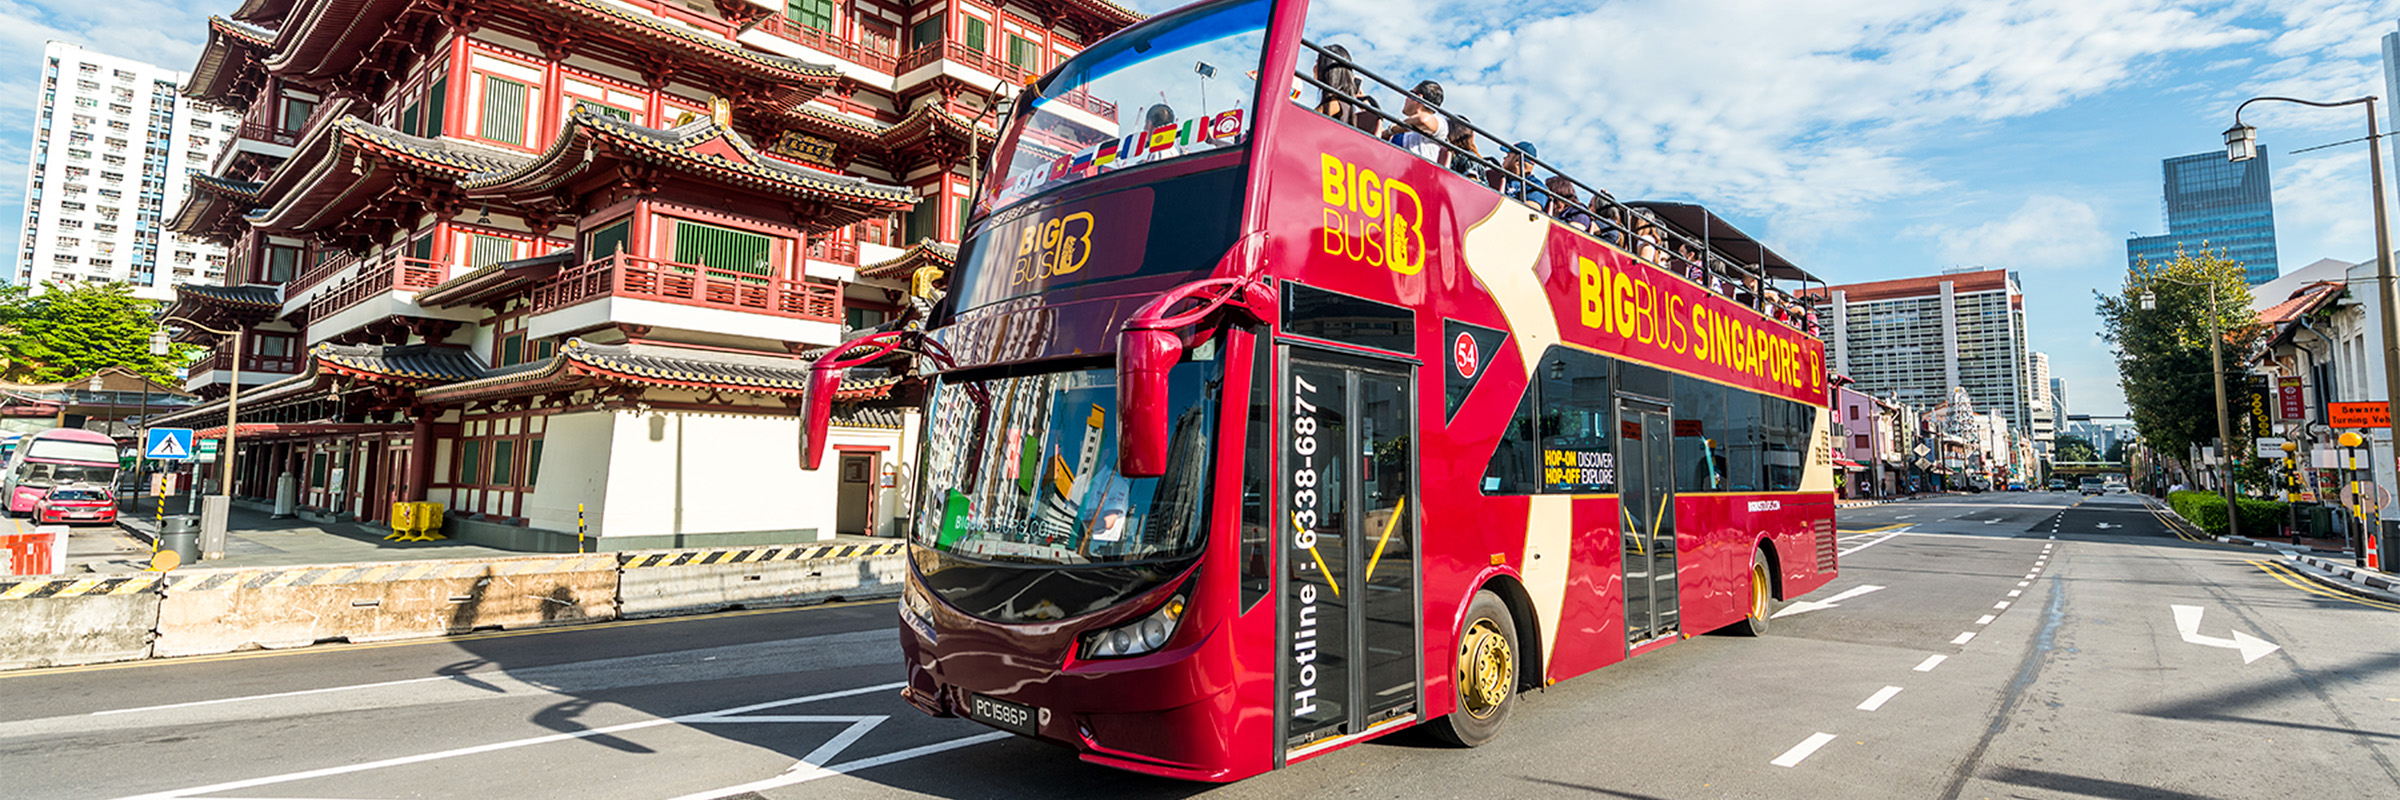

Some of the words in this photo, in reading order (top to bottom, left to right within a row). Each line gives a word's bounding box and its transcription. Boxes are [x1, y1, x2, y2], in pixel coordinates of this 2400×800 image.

[1321, 152, 1383, 219] BIG
[1019, 217, 1061, 257] BIG
[1323, 206, 1384, 267] BUS
[1012, 250, 1055, 286] BUS
[1457, 342, 1476, 369] 54
[1692, 303, 1802, 388] SINGAPORE
[2332, 416, 2368, 425] Turning
[2342, 406, 2381, 414] Beware
[1294, 375, 1317, 550] 6338-6877
[1545, 449, 1577, 467] HOP-ON
[1578, 451, 1614, 468] DISCOVER
[1545, 467, 1580, 485] HOP-OFF
[1581, 468, 1614, 485] EXPLORE
[1294, 583, 1317, 717] Hotline
[976, 699, 1028, 727] PC1586P
